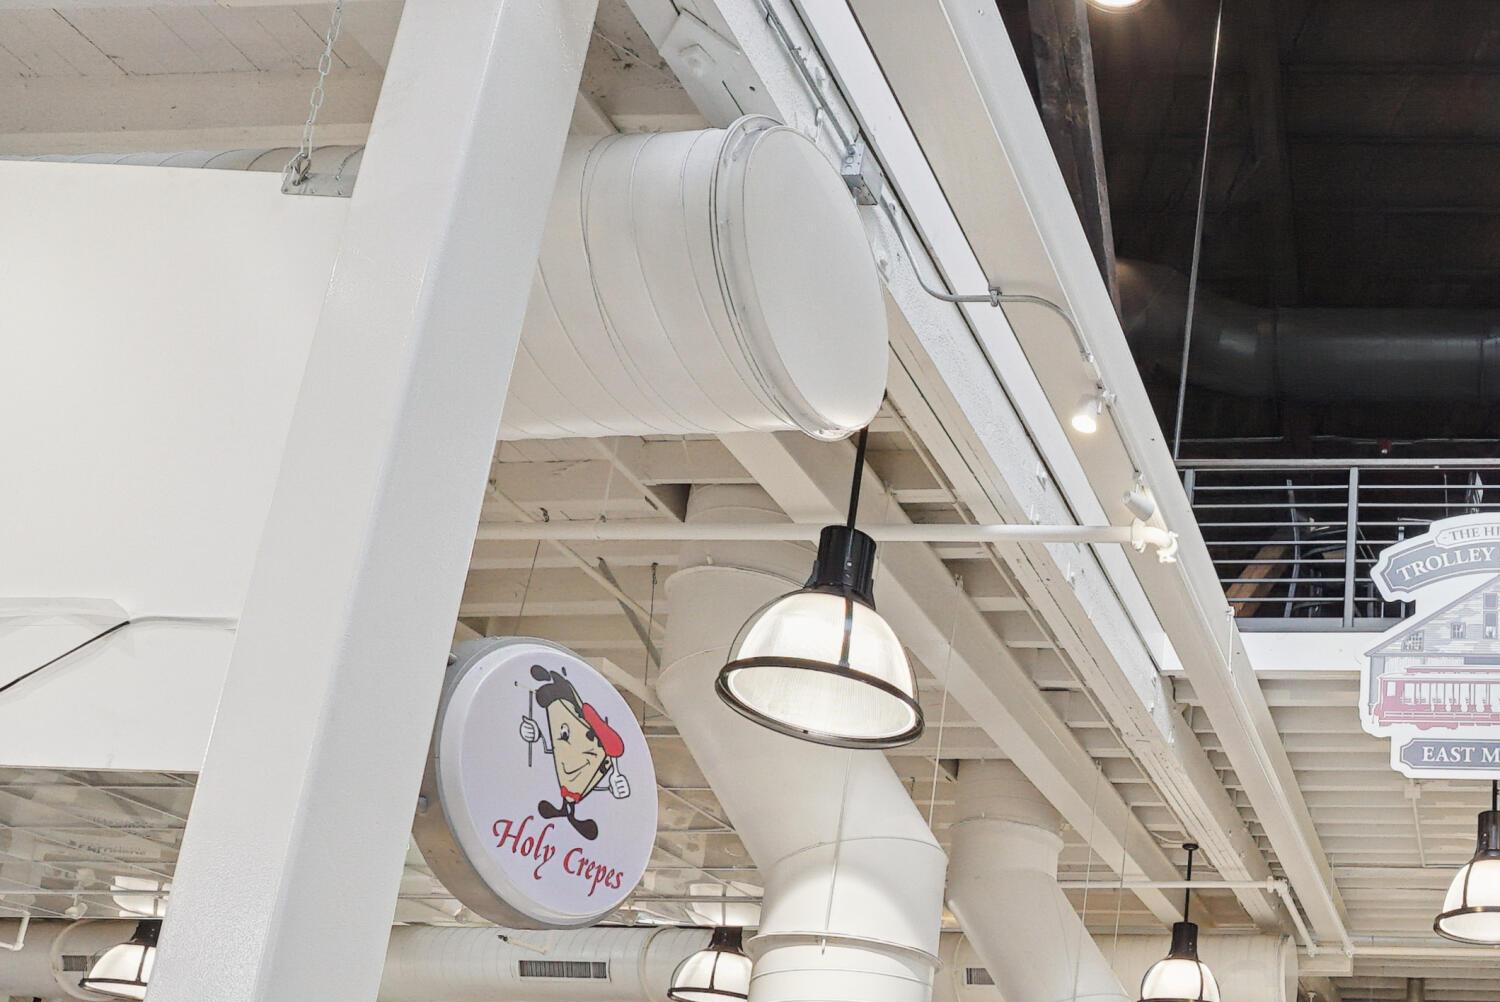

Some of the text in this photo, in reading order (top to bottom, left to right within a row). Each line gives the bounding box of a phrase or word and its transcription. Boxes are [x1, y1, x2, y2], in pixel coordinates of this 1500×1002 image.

[1449, 528, 1480, 541] THE
[1396, 547, 1496, 582] TROLLEY
[1422, 746, 1475, 763] EAST
[492, 816, 624, 897] Holy Crepes
